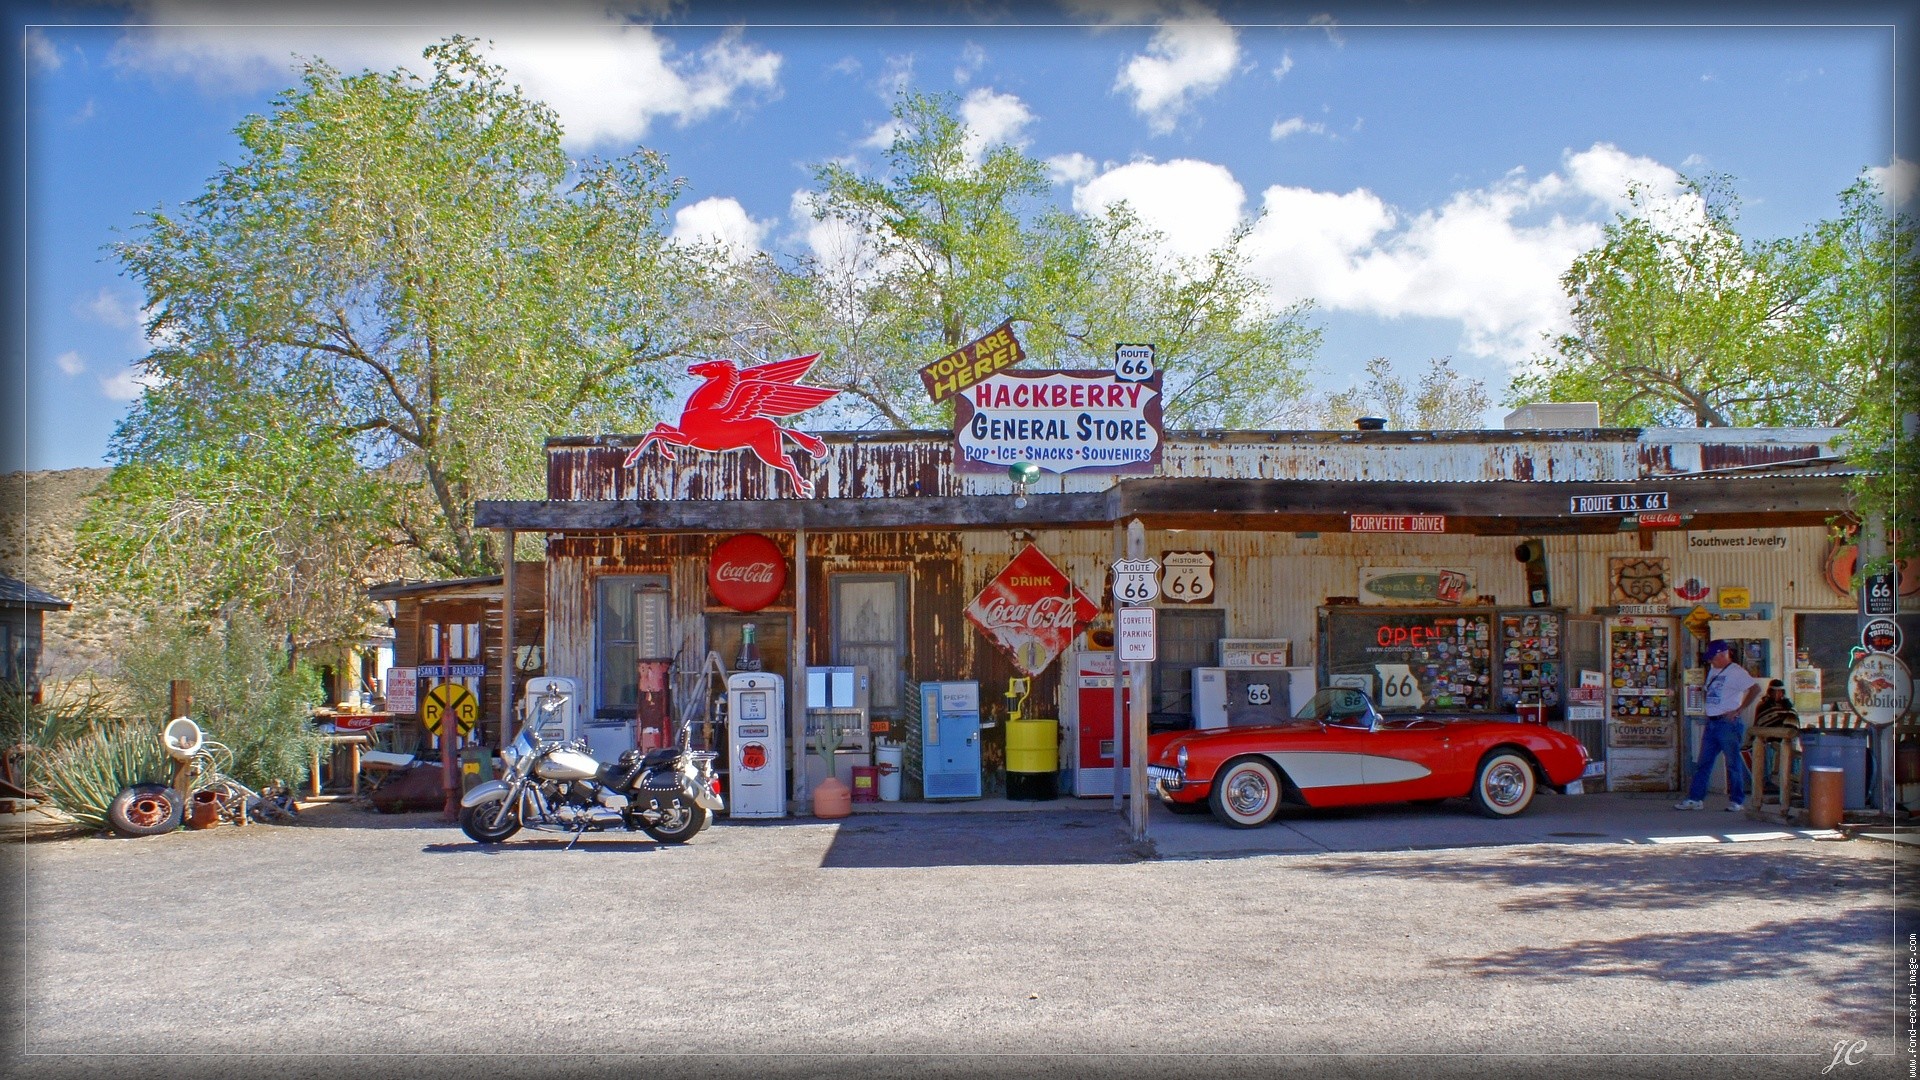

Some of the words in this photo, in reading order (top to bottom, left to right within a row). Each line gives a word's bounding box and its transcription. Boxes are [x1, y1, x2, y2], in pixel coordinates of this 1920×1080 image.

[926, 351, 968, 381] YOU
[975, 330, 1010, 359] ARE
[1121, 350, 1149, 358] ROUTE
[934, 343, 1018, 399] HERE!
[1122, 360, 1147, 375] 66
[976, 383, 1142, 408] HACKBERRY
[971, 412, 1069, 440] GENERAL
[1076, 412, 1147, 441] STORE
[965, 446, 989, 460] POP
[997, 446, 1017, 460] ICE
[1025, 446, 1074, 460] SNACKS
[1082, 446, 1150, 461] SOUVENIRS
[1579, 497, 1613, 512] ROUTE
[1620, 495, 1640, 511] U.S.
[1645, 494, 1660, 509] 66
[1355, 516, 1405, 531] CORVETTE
[1412, 517, 1440, 531] DRIVE
[1690, 535, 1745, 548] Southwest
[1747, 535, 1787, 549] Jewelry
[716, 561, 776, 583] Coca-Cola
[1123, 564, 1150, 572] ROUTE
[1010, 576, 1052, 587] DRINK
[1172, 575, 1203, 594] 66
[1630, 579, 1653, 596] 66
[1124, 583, 1149, 599] 66
[1871, 584, 1891, 598] 66
[985, 596, 1081, 629] Coca-Cola
[1621, 605, 1641, 614] ROUTE
[1656, 605, 1665, 614] 66
[1868, 628, 1895, 638] TRITON
[1870, 622, 1894, 631] ROYAL
[1122, 630, 1152, 638] PARKING
[1377, 625, 1441, 648] OPEN
[1129, 644, 1146, 652] ONLY
[1226, 642, 1248, 650] SERVE
[522, 659, 534, 667] 66
[1250, 651, 1282, 665] ICE
[397, 670, 407, 678] NO
[420, 666, 438, 675] SANTA
[452, 666, 480, 675] RAILROAD
[389, 679, 416, 687] DUMPING
[1385, 675, 1412, 698] 66
[1250, 689, 1268, 700] 66
[427, 705, 438, 719] R
[462, 704, 474, 718] R
[747, 756, 759, 765] 66
